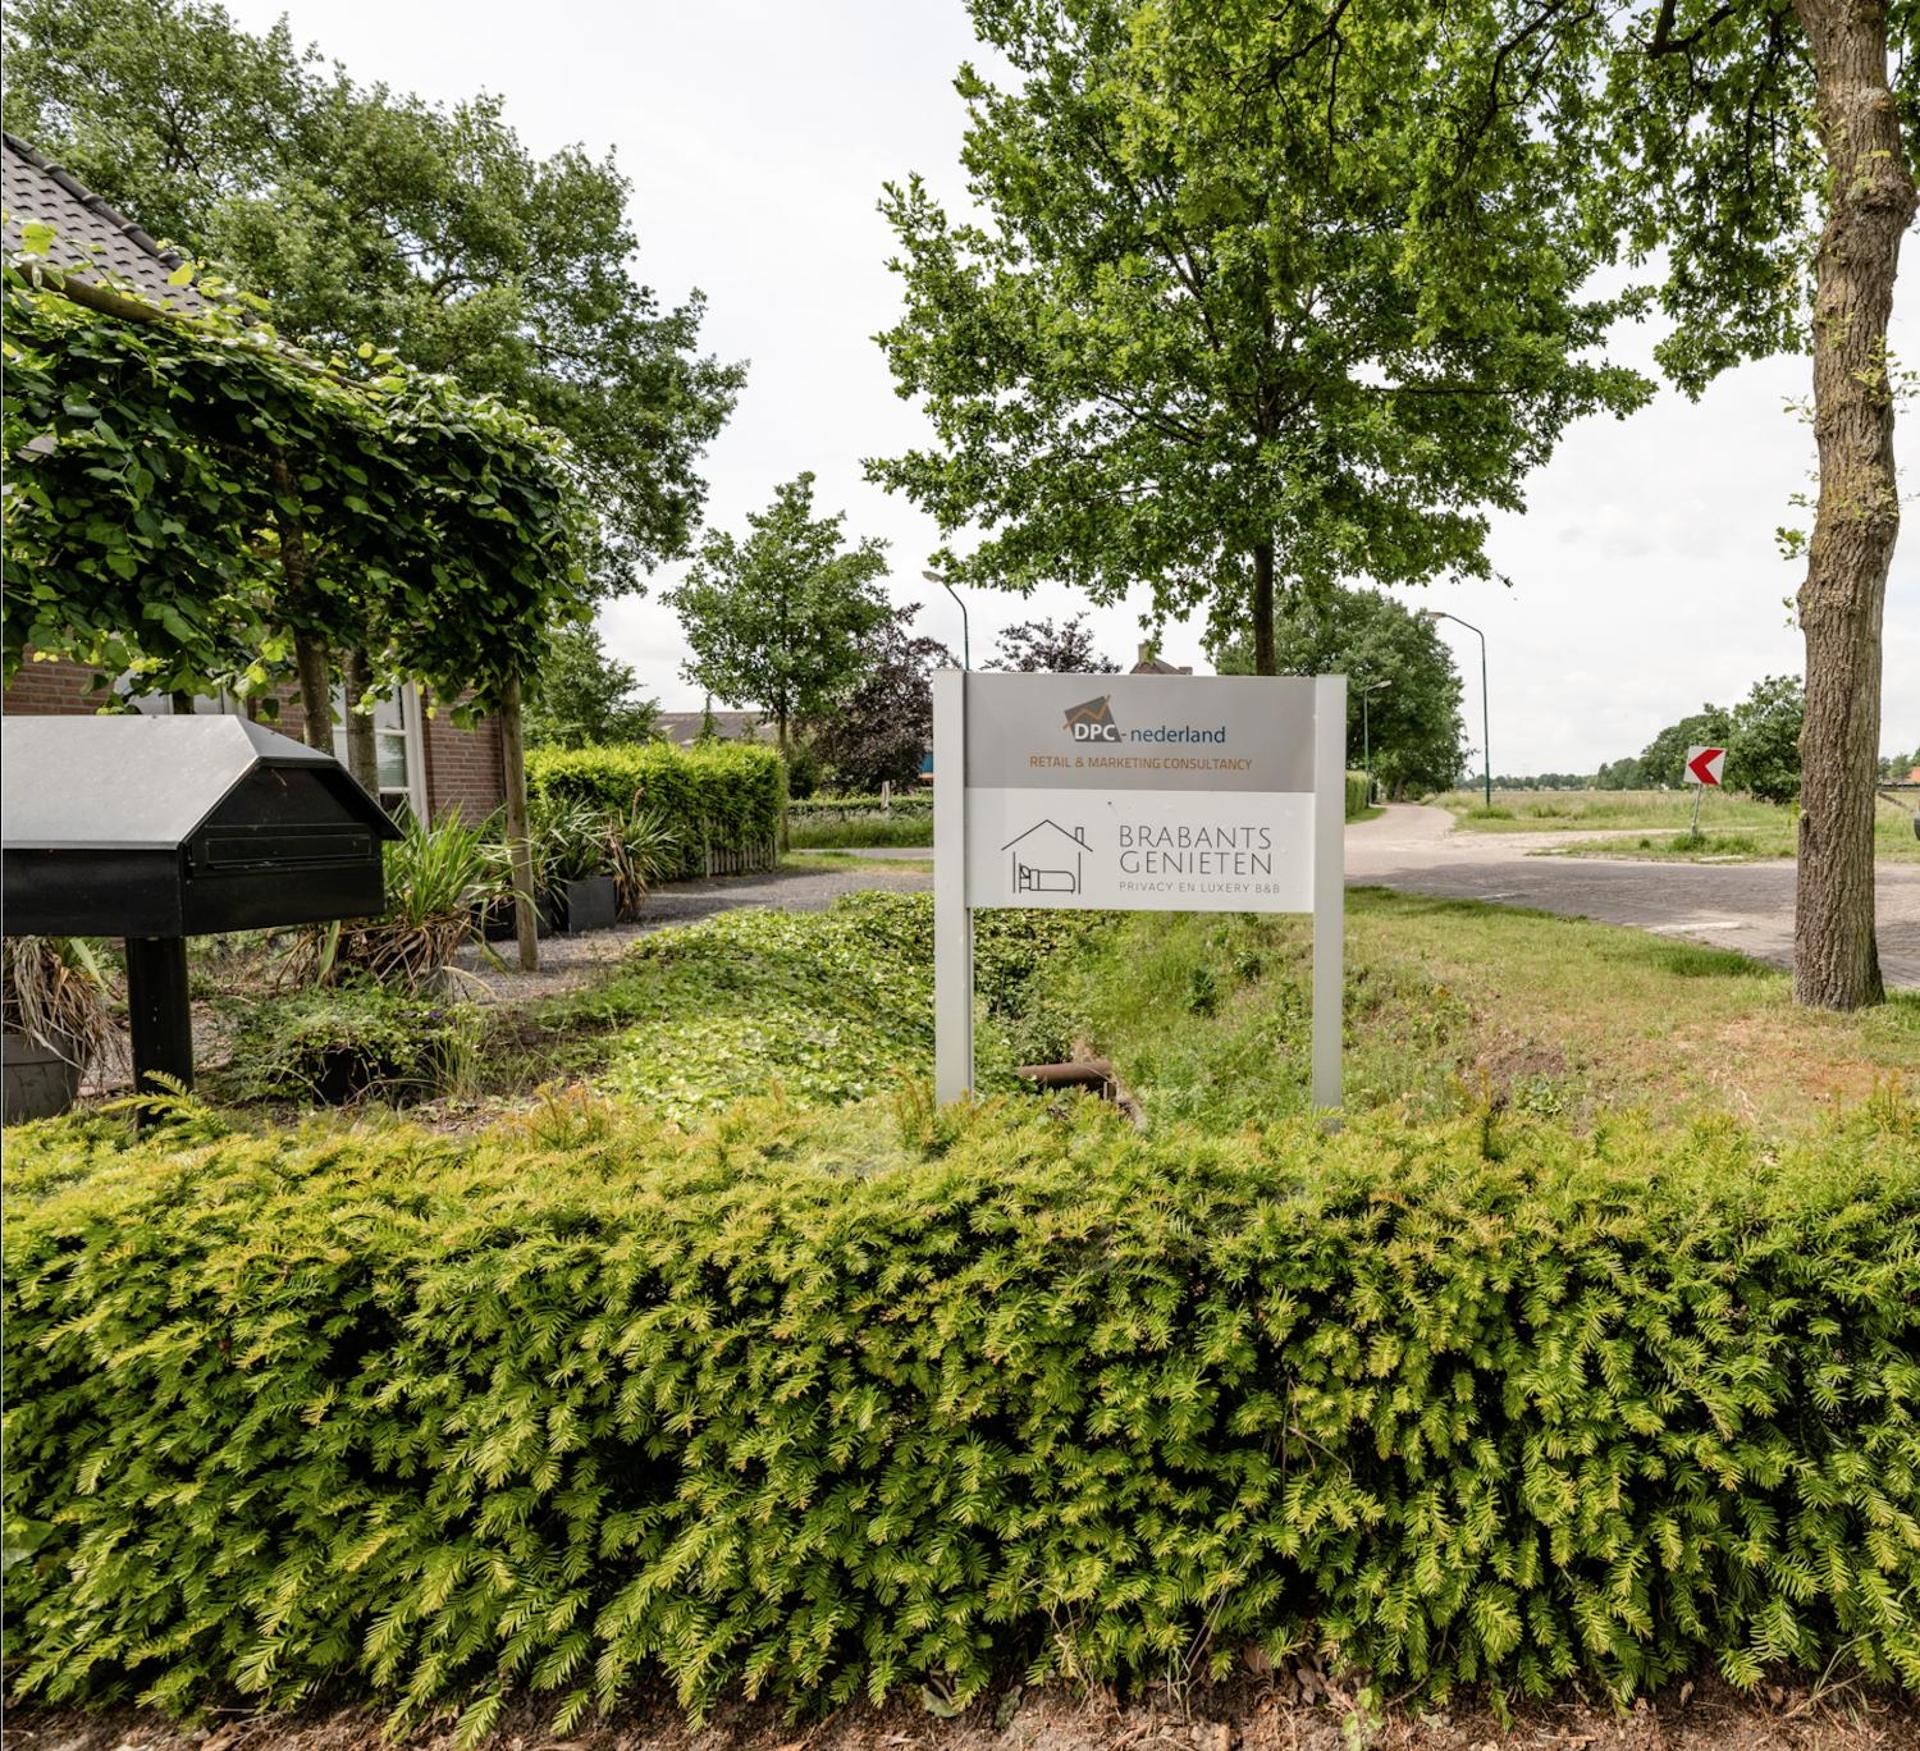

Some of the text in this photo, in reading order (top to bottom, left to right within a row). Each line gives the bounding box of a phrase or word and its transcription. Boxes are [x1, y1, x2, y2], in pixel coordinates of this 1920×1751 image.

[1029, 756, 1252, 770] RETAIL & MARKETING CONSULTANCY
[1119, 825, 1272, 850] BRABANTS
[1119, 850, 1272, 875] GENIETEN
[1119, 881, 1281, 894] PRIVACY EN LUXERY B&B
